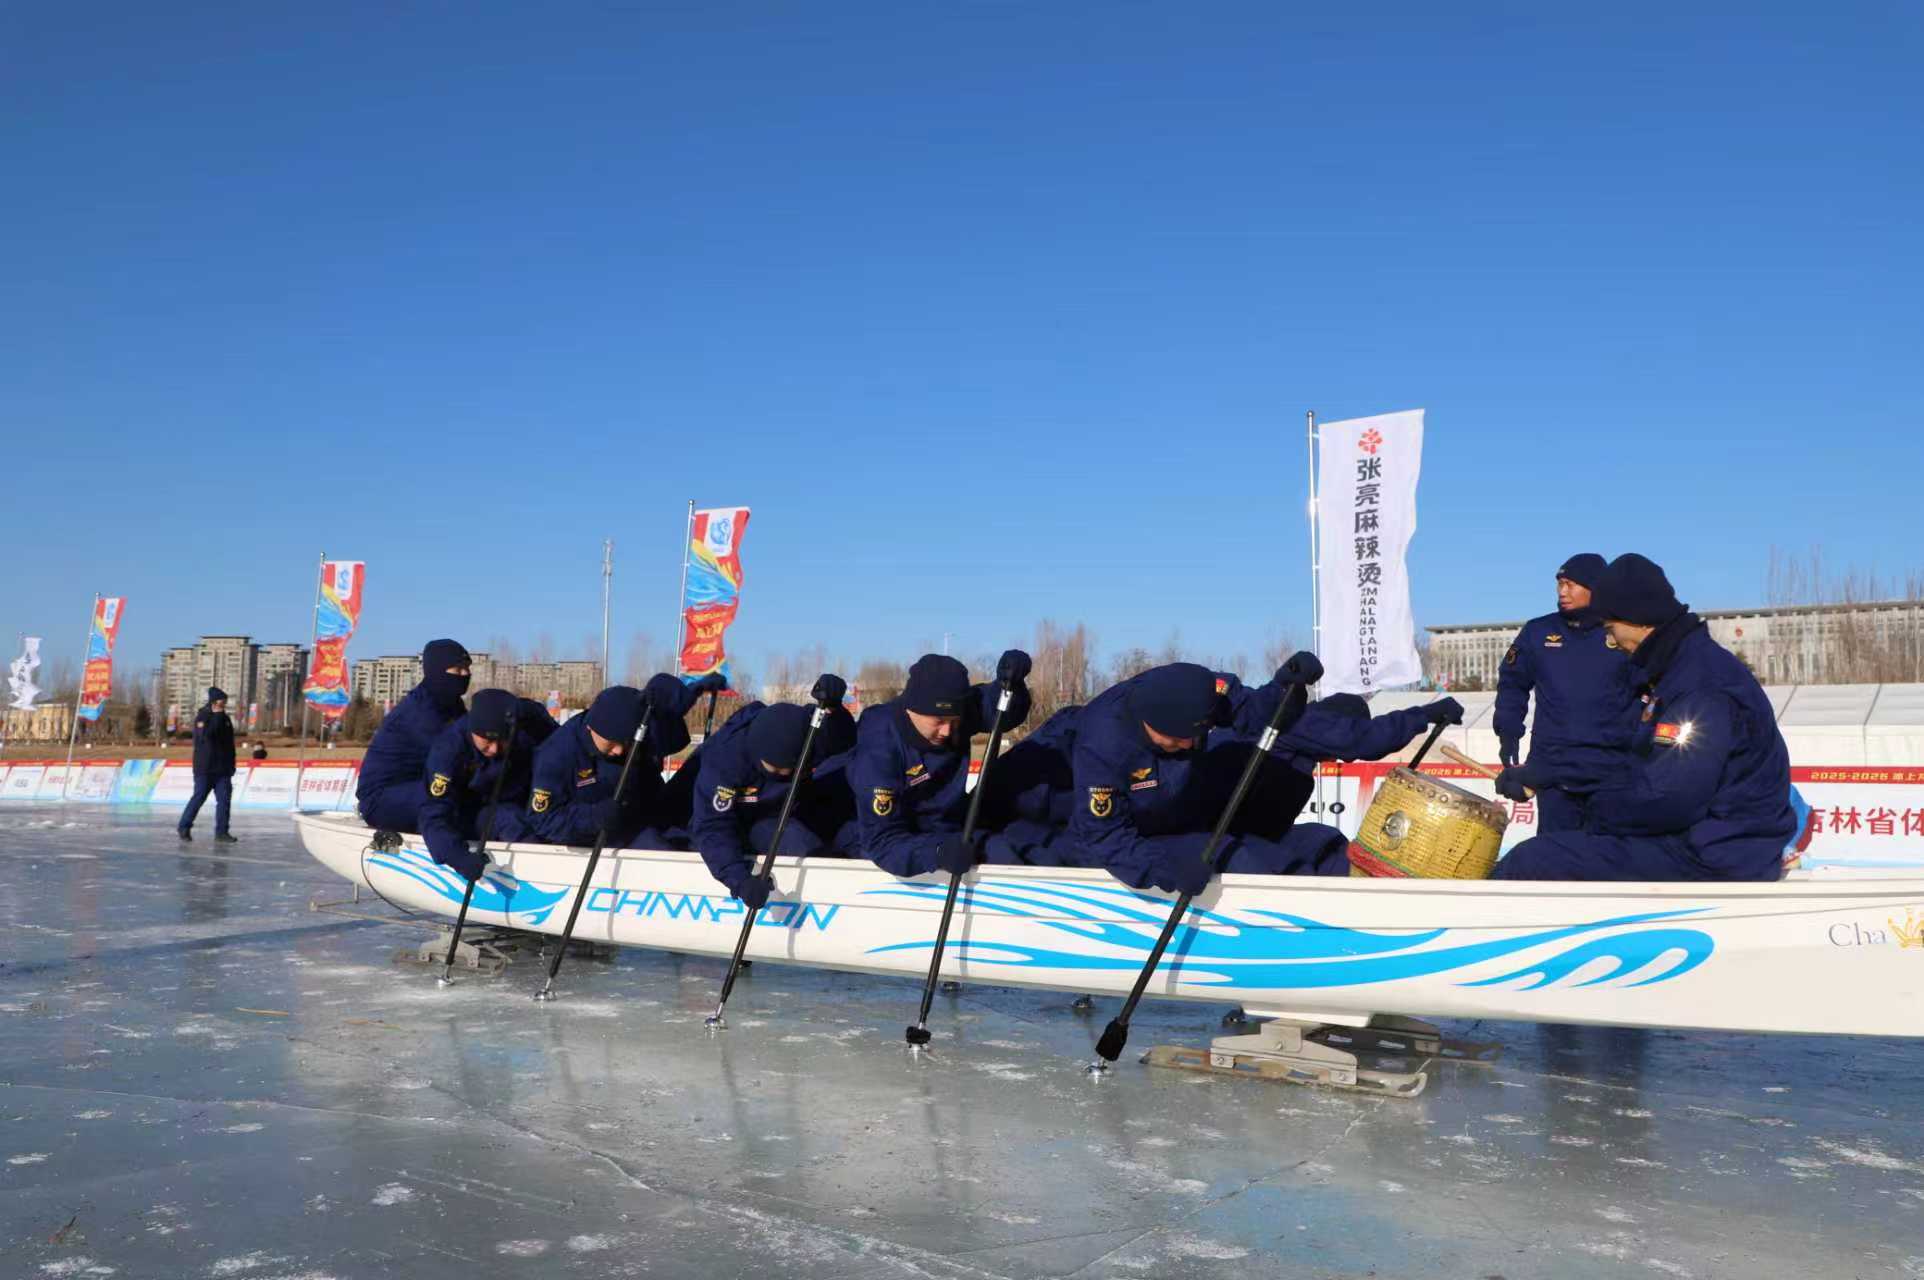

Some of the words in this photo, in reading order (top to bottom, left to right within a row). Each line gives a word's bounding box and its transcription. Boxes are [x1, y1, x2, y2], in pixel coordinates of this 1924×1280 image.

[1354, 458, 1382, 588] 张亮麻辣烫
[1359, 588, 1371, 687] ZHANGLIANG
[1366, 587, 1378, 666] MALATANG
[1811, 771, 1888, 780] 2025-2026
[586, 888, 839, 931] CHAMPON
